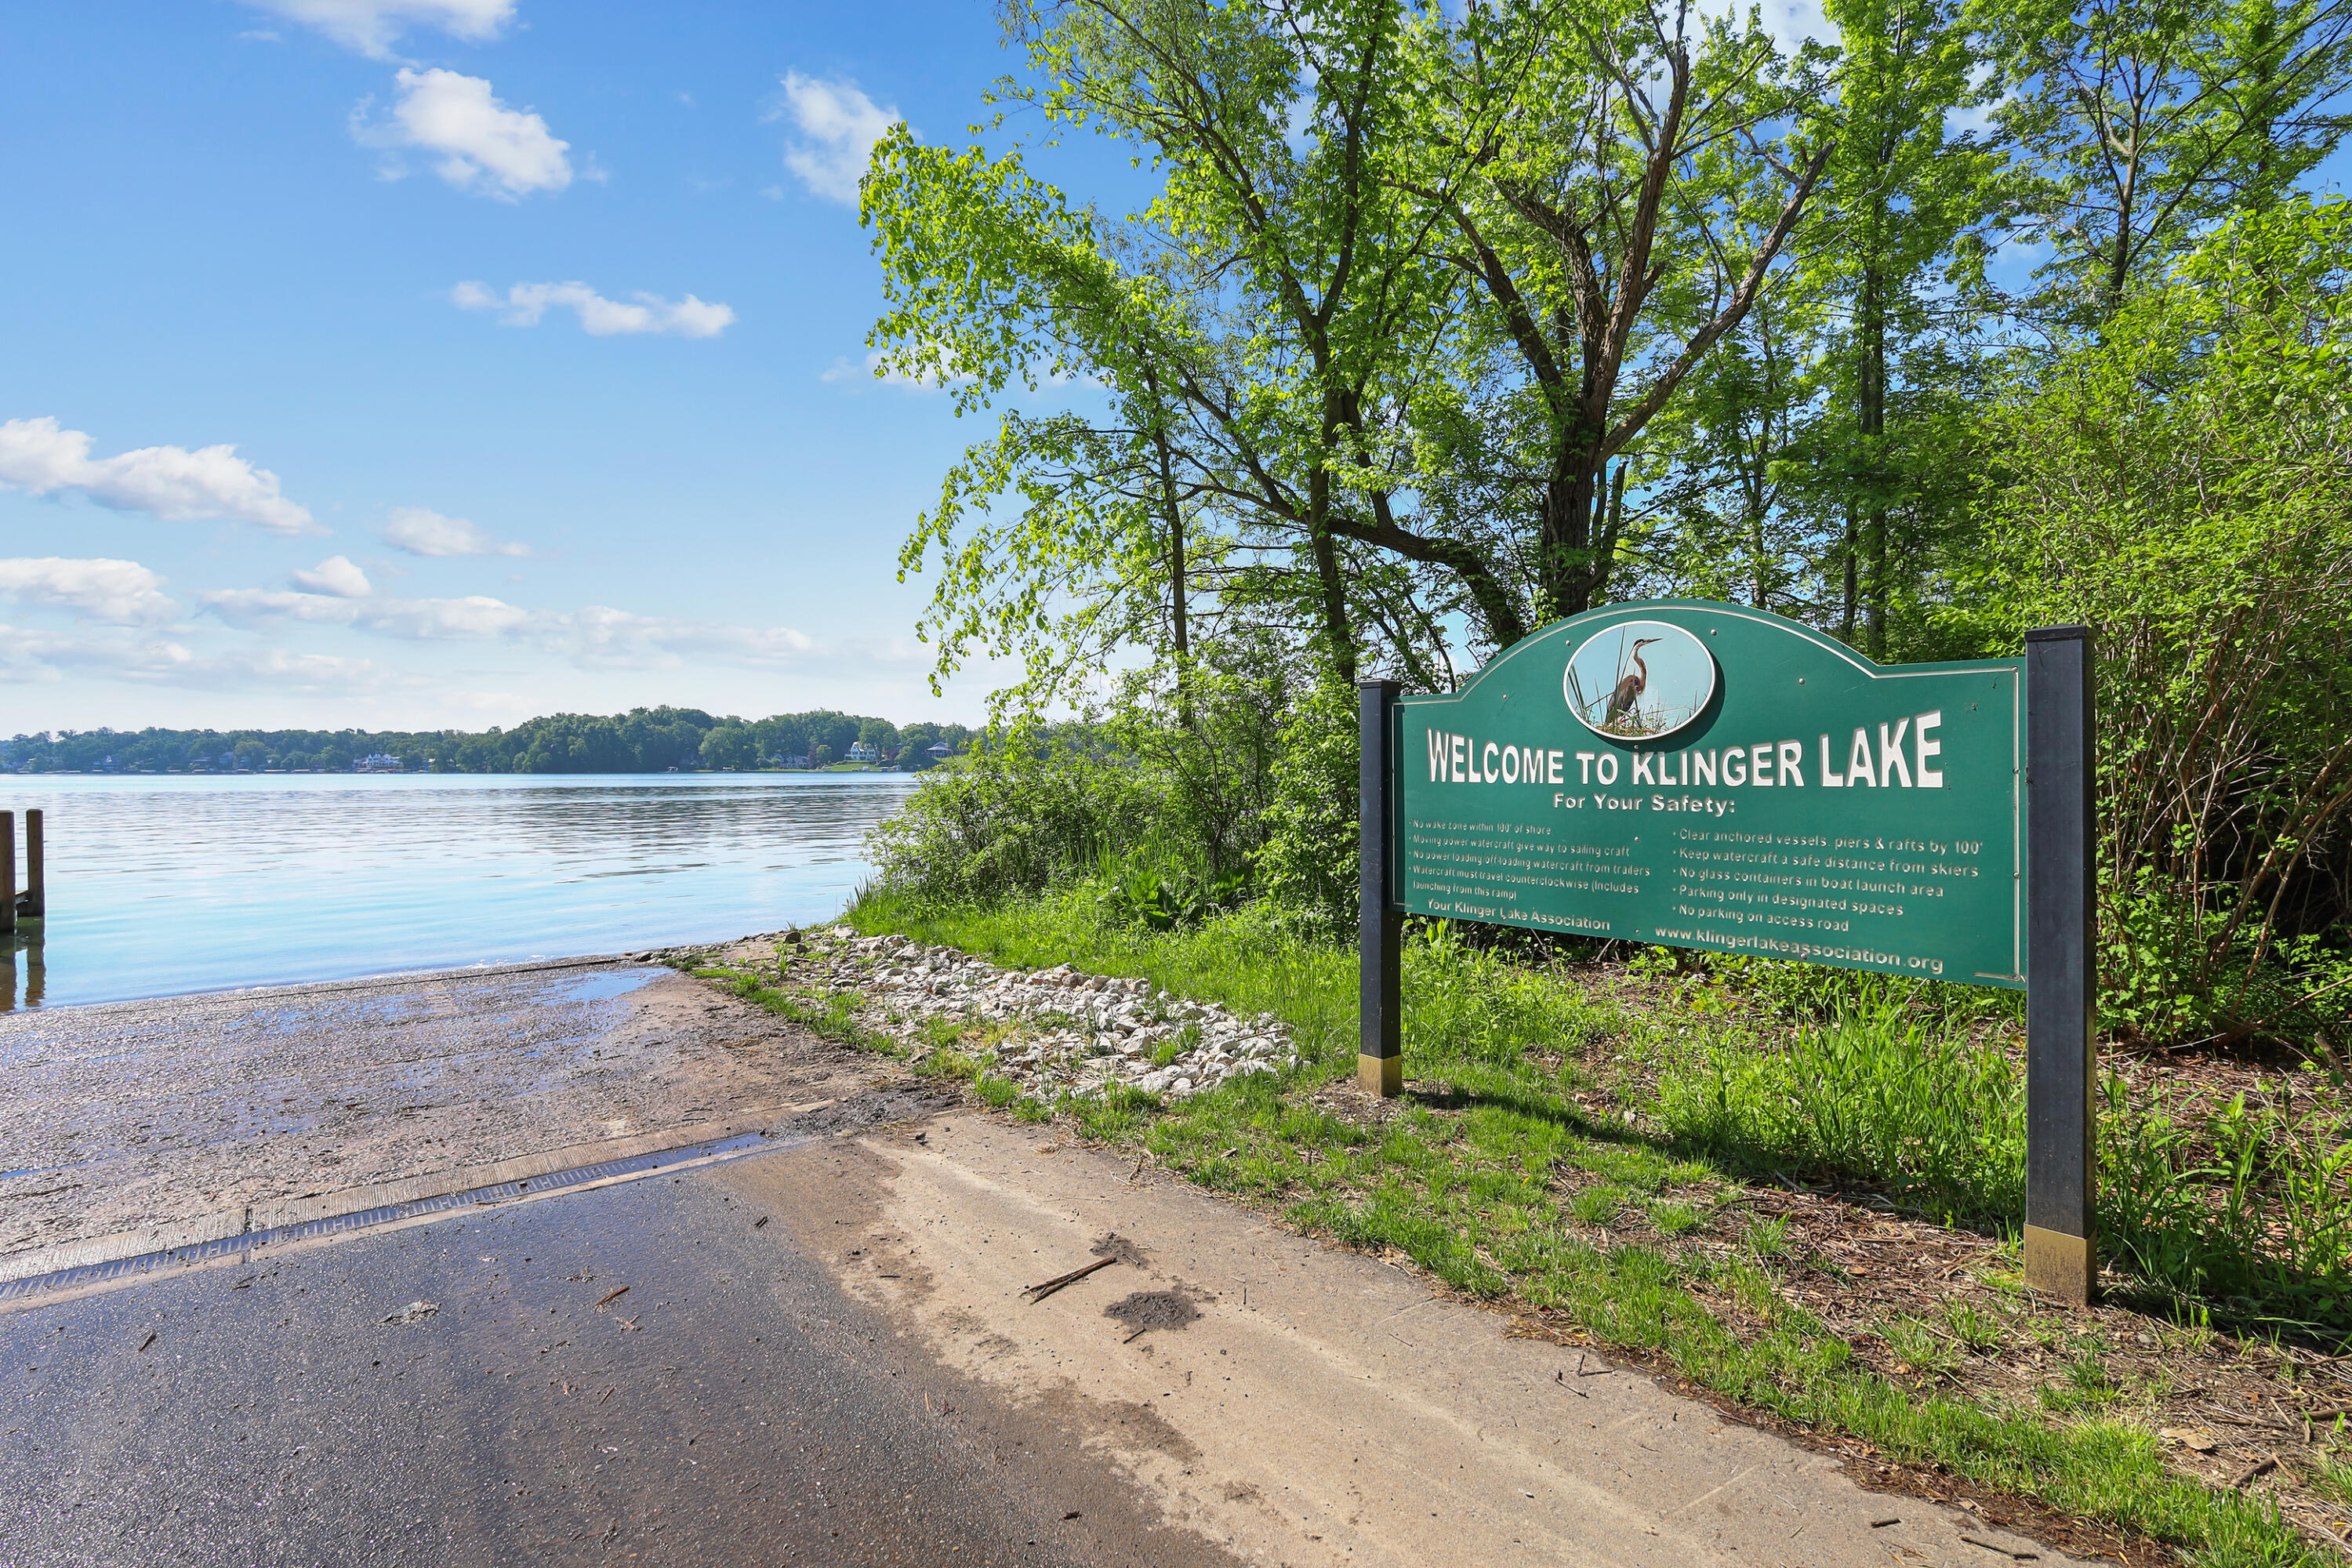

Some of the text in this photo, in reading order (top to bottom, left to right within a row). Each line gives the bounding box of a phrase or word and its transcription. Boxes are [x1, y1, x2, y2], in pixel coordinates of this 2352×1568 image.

[1426, 709, 1944, 788] WELCOME TO KLINGER LAKE
[1553, 792, 1736, 818] For Your Safety:
[1413, 818, 1424, 829] No
[1425, 820, 1446, 829] wake
[1447, 822, 1467, 831] zone
[1469, 822, 1494, 832] within
[1514, 824, 1523, 833] of
[1525, 824, 1551, 835] shore
[1413, 834, 1630, 858] Moving power watercraft give way to sailing craft
[1679, 828, 1710, 840] Clear
[1713, 829, 1773, 844] anchored
[1835, 836, 1870, 851] piers
[1875, 836, 1885, 850] &
[1889, 838, 1926, 852] rafts
[1929, 840, 1947, 855] by
[1413, 850, 1424, 859] No
[1425, 852, 1450, 861] power
[1534, 861, 1583, 872] watercraft
[1585, 862, 1610, 873] from
[1613, 863, 1650, 877] trailers
[1679, 848, 1980, 877] Keep watercraft a safe distance from skiers
[1413, 865, 1639, 894] Watercraft must travel counterclockwise (Includes
[1413, 880, 1517, 901] launching from this ramp)
[1679, 866, 1944, 897] No glass containers in boat launch area
[1428, 898, 1611, 931] Your Klinger Lake Association
[1679, 884, 1904, 916] Parking only in designated spaces
[1679, 903, 1849, 932] No parking on access road
[1655, 926, 1944, 975] www.klingerlakeassociation.org
